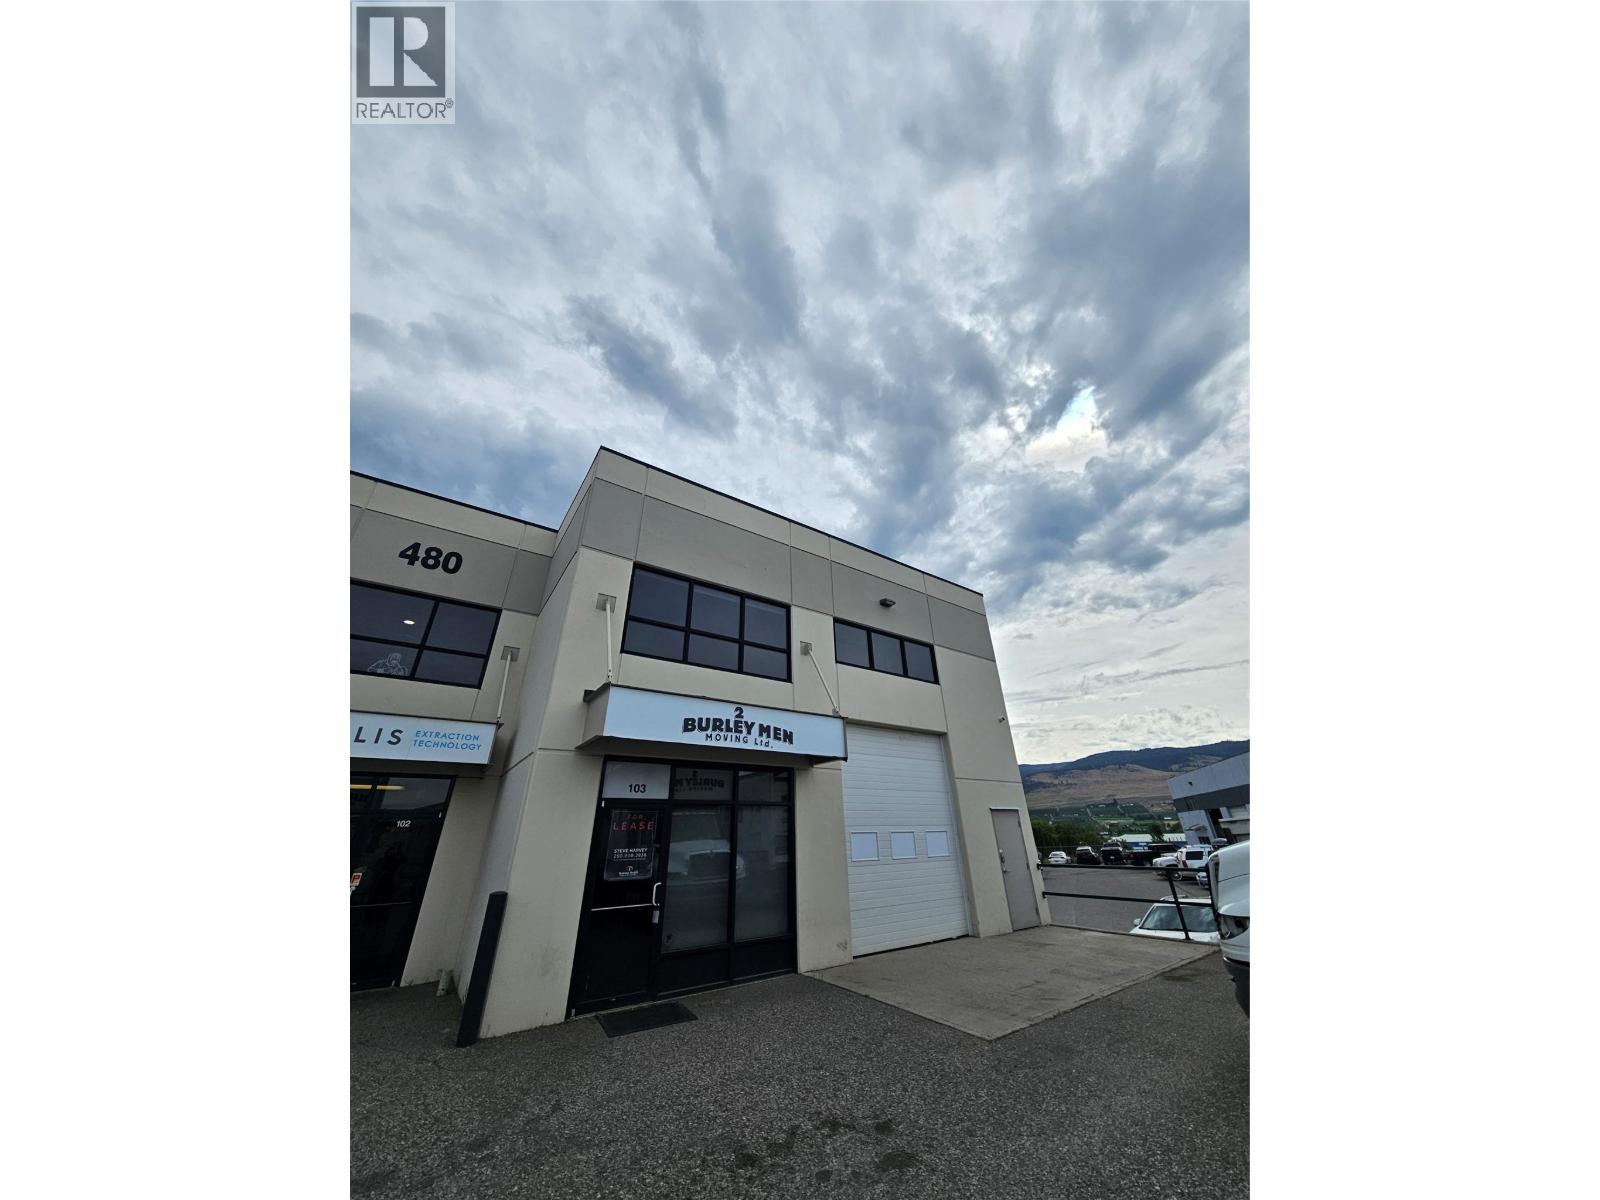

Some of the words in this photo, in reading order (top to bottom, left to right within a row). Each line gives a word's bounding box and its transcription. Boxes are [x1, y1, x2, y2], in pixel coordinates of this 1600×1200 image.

[398, 542, 463, 575] 480
[734, 706, 744, 719] 2
[353, 726, 404, 746] LIS
[415, 730, 480, 742] EXTRACTION
[682, 717, 756, 736] BURLEY
[758, 723, 794, 745] MEN
[705, 733, 749, 744] MOVING
[413, 740, 482, 751] TECHNOLOGY
[628, 783, 647, 793] 103
[397, 820, 412, 828] 102
[613, 821, 655, 831] LEASE
